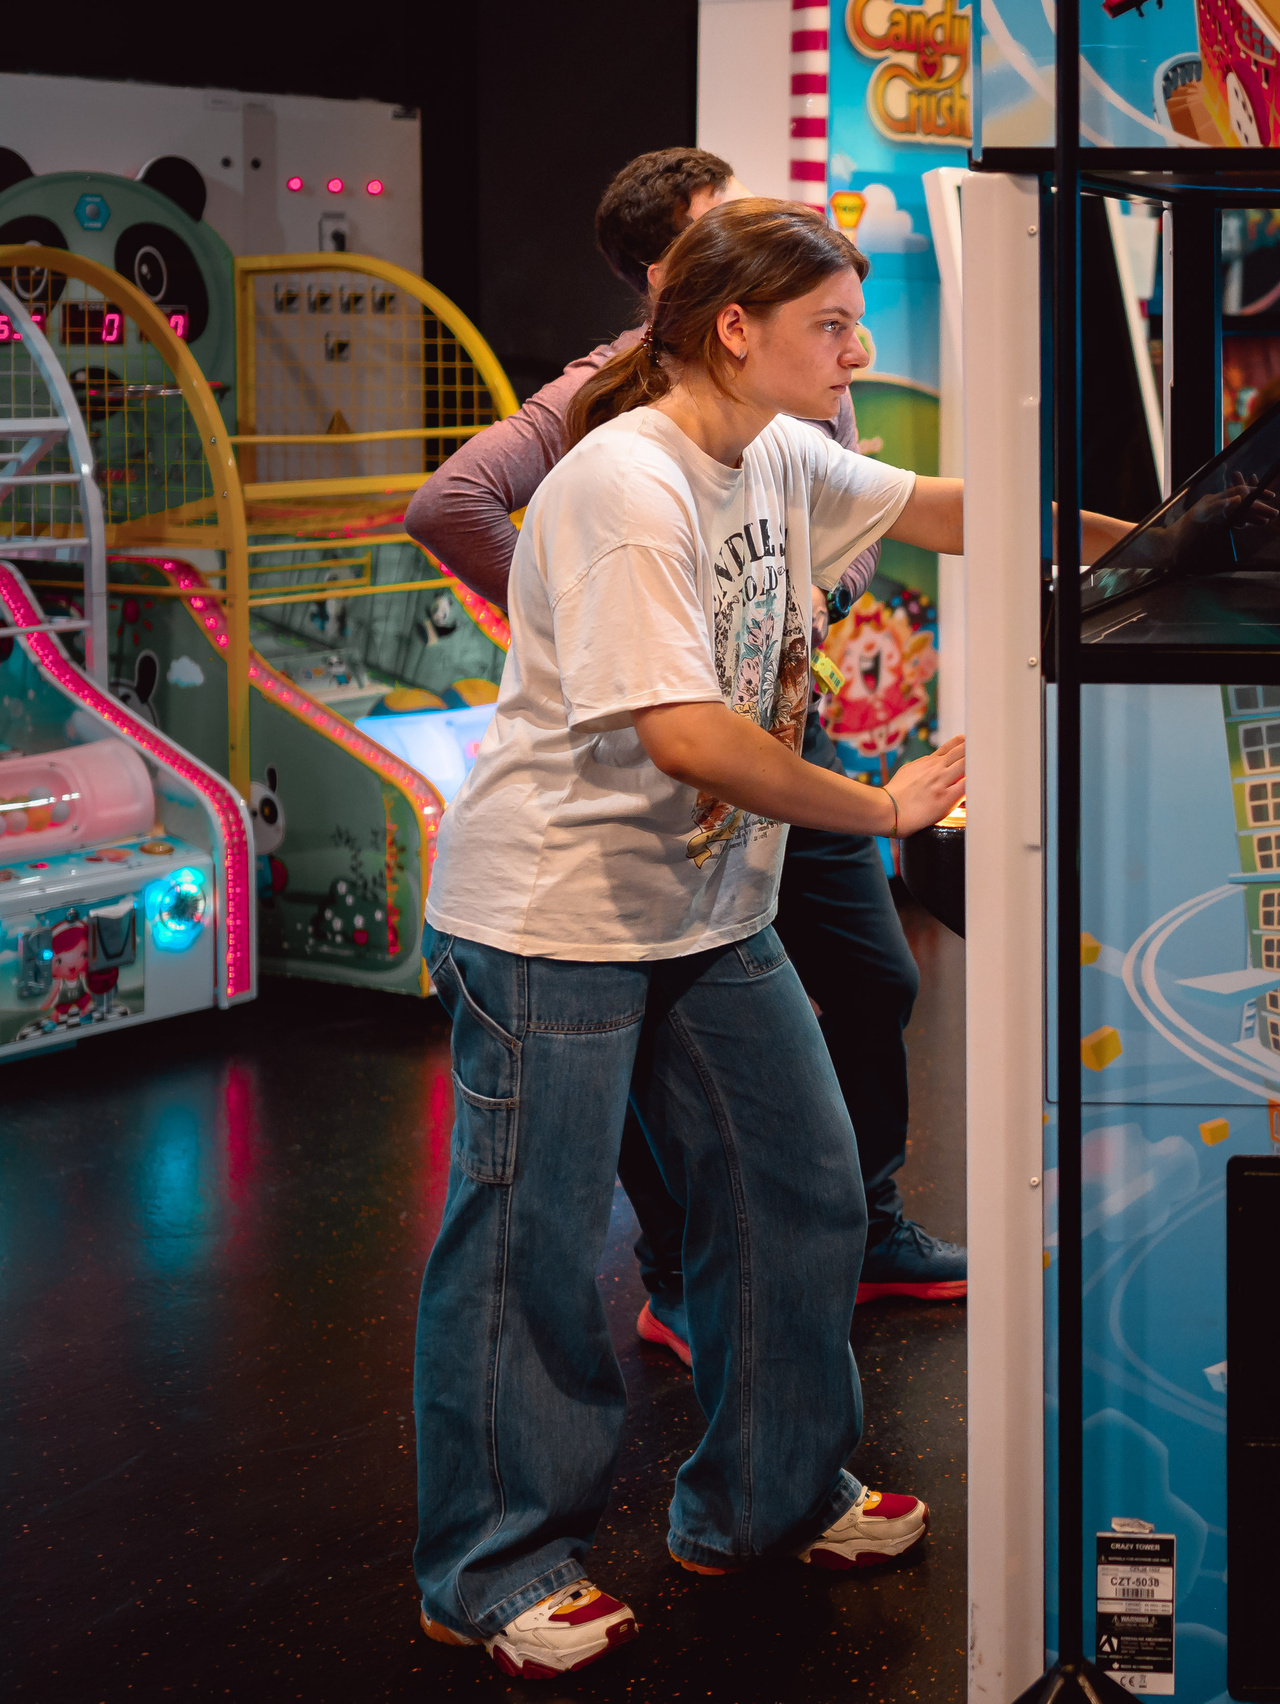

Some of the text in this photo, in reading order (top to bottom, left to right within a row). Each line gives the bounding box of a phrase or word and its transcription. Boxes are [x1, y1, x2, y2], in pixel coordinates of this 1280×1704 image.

[851, 0, 971, 82] Candy
[873, 63, 972, 139] Crush
[1135, 1543, 1160, 1551] TOWER
